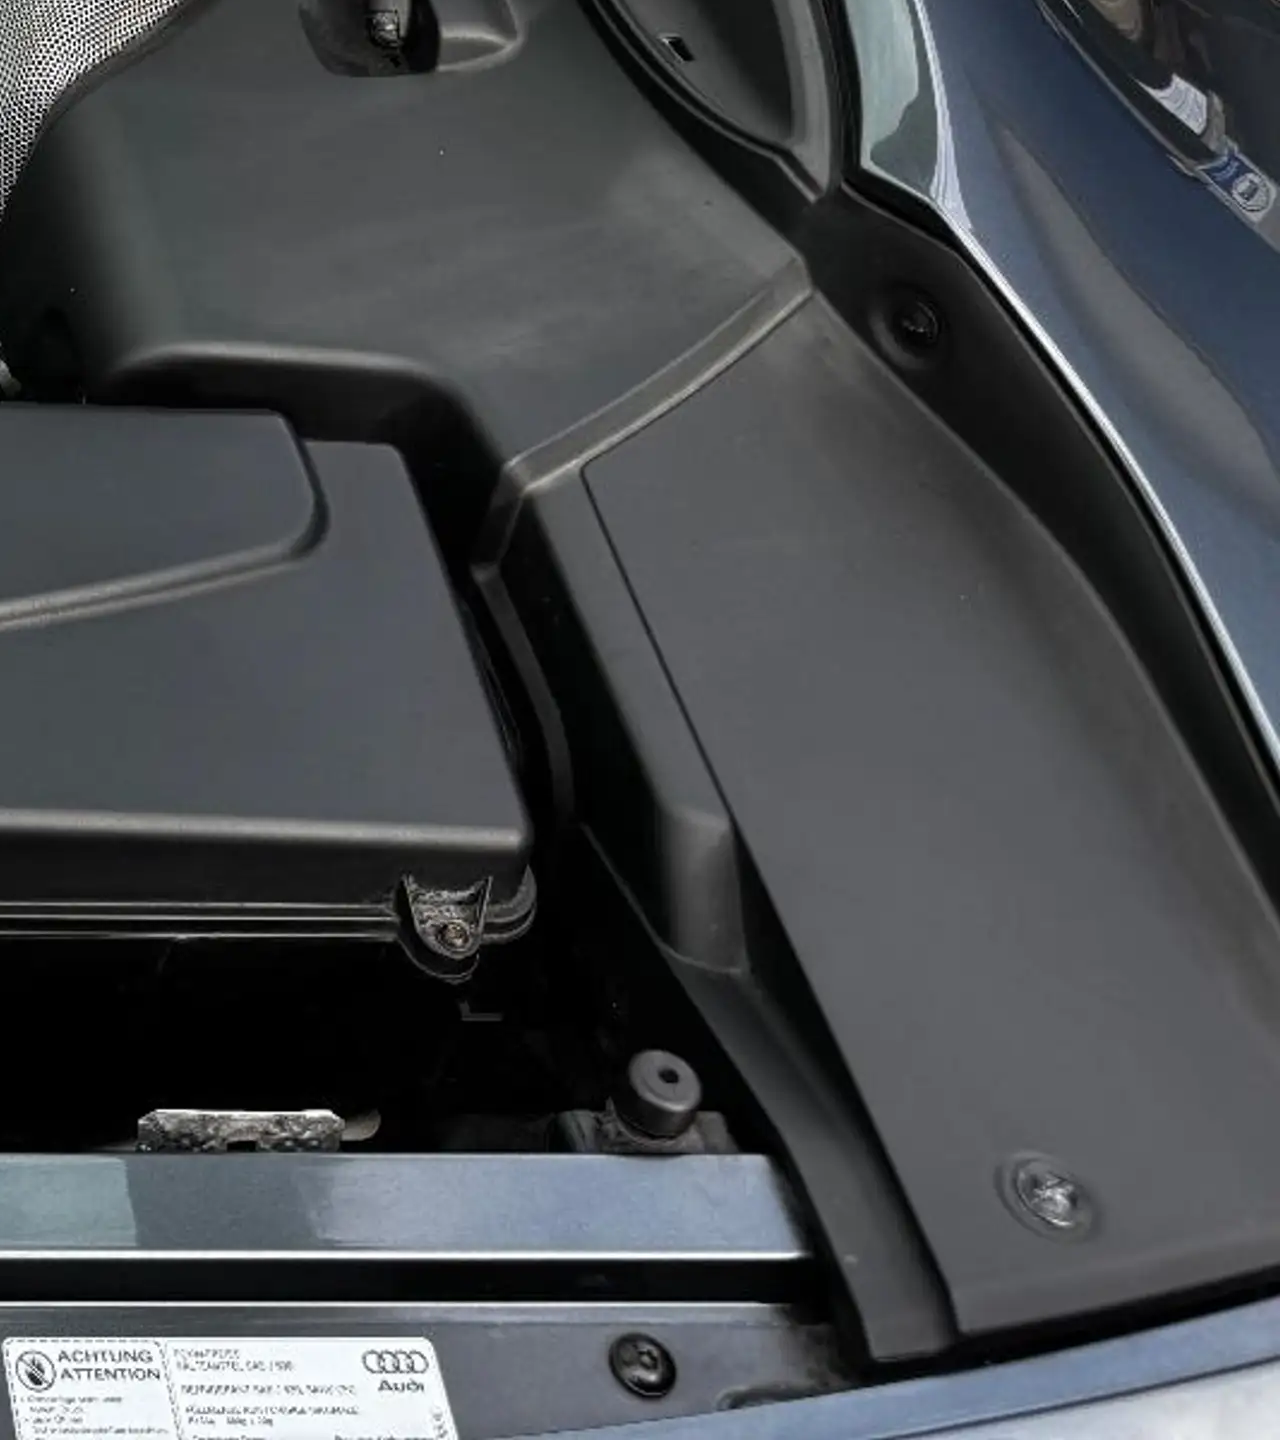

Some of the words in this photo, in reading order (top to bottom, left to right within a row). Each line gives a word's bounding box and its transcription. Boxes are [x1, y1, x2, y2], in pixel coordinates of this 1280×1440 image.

[57, 1349, 154, 1363] ACHTUNG
[60, 1367, 161, 1381] ATTENTION
[378, 1379, 425, 1393] Audi
